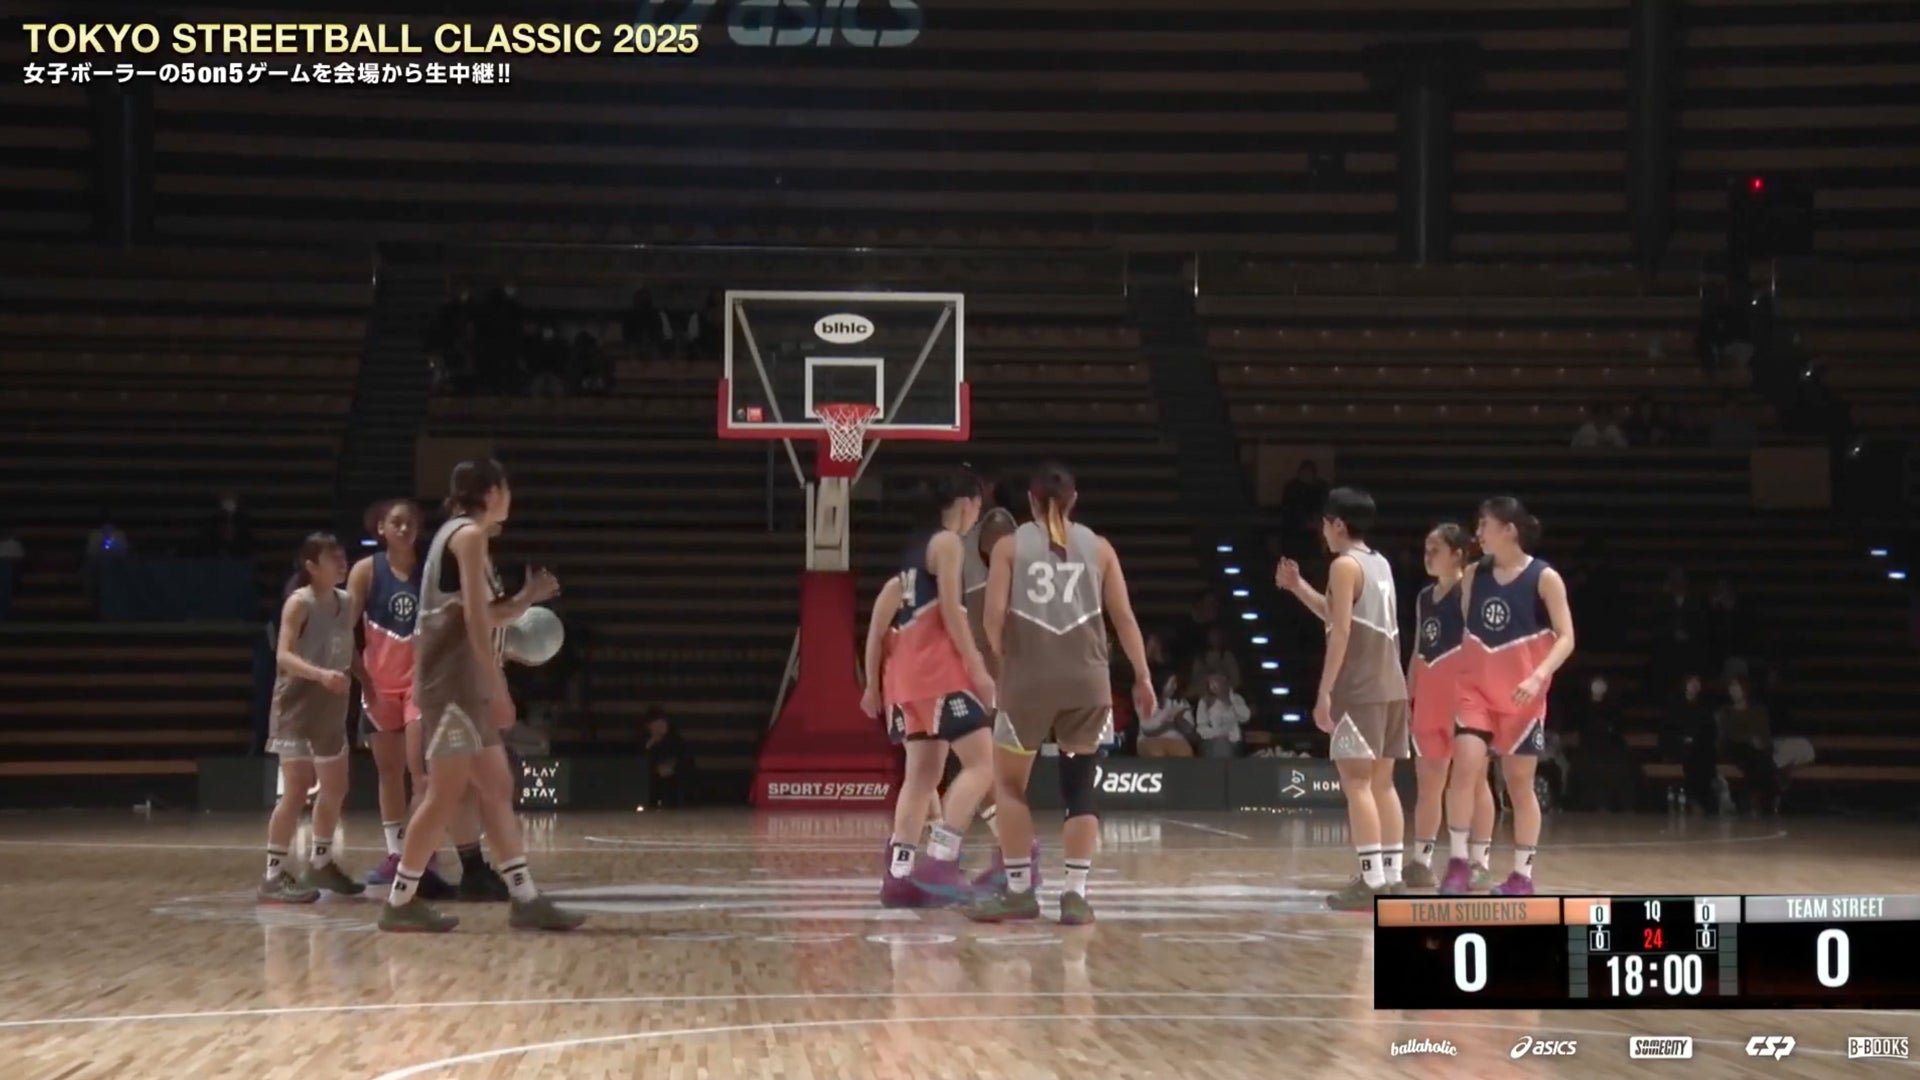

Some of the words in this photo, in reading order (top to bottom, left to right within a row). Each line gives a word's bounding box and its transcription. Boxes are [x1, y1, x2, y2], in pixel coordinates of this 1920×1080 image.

[1026, 561, 1085, 605] 37
[522, 787, 556, 798] STAY
[1102, 772, 1163, 793] asics
